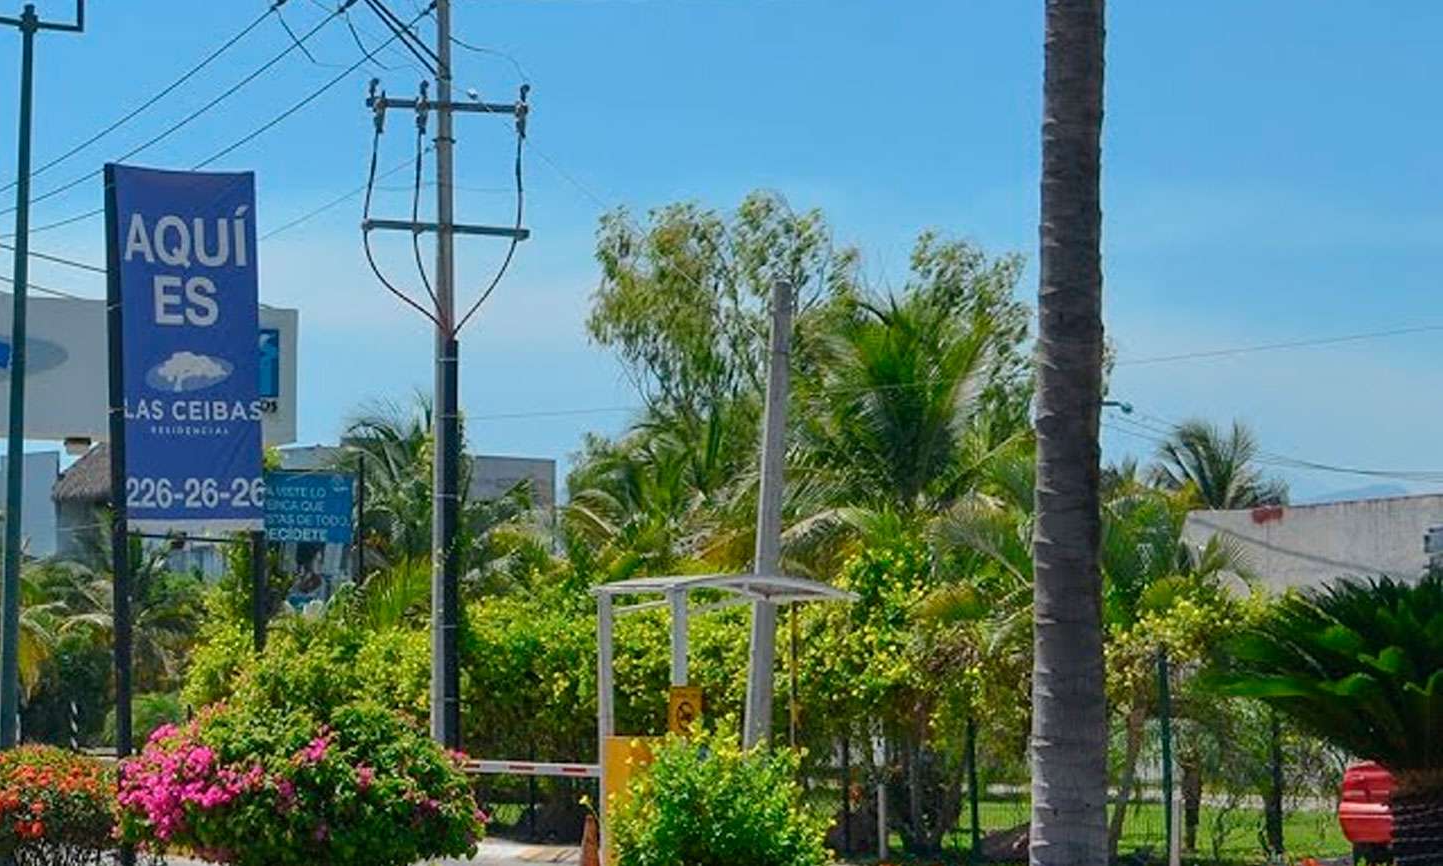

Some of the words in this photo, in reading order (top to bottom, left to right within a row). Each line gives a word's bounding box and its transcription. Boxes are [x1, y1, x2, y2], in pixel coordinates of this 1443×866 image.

[124, 205, 249, 269] AQUÍ
[153, 274, 219, 326] ES
[123, 397, 164, 421] LAS
[171, 399, 262, 421] CEIBAS
[150, 425, 229, 436] RESIDENCIAL
[125, 477, 266, 509] 226-26-26
[266, 499, 299, 511] ERCA
[301, 500, 326, 513] QUE
[264, 512, 295, 525] STAS
[296, 513, 315, 526] DE
